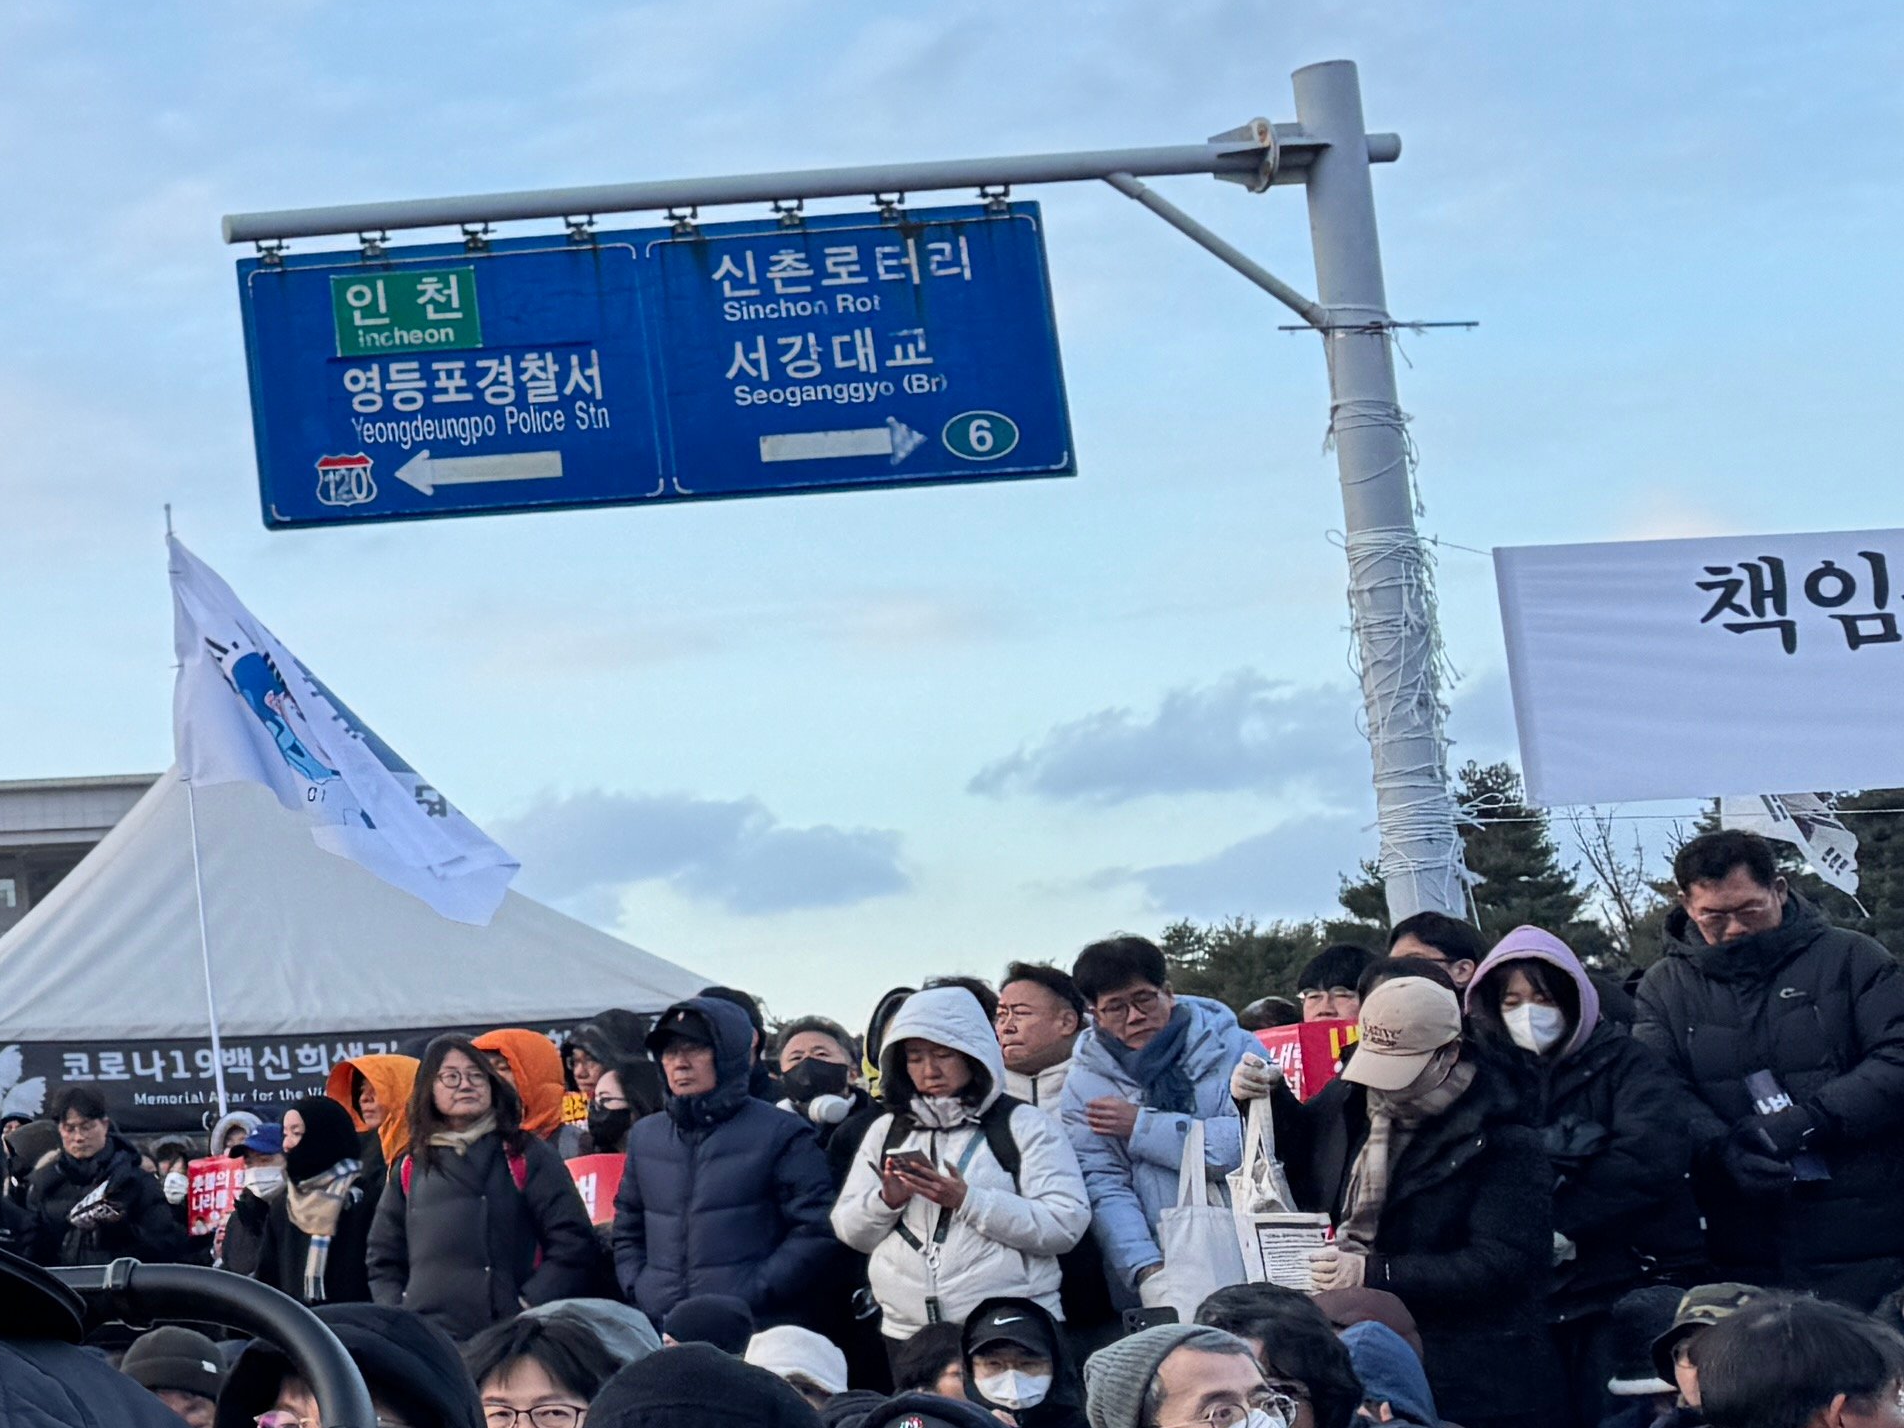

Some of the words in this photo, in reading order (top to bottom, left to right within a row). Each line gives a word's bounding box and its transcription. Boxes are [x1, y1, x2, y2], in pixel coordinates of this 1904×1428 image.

[711, 235, 972, 298] 신촌로터리
[346, 274, 464, 326] 인천
[723, 299, 829, 322] Sinchon
[725, 327, 934, 382] 서강대교
[343, 349, 604, 414] 영등포경찰서
[734, 378, 895, 407] Seoganggyo
[351, 414, 497, 450] Yeongdeungpo
[505, 405, 566, 435] Police
[575, 400, 610, 429] Stn
[968, 419, 994, 452] 6
[324, 468, 368, 502] 120
[1696, 550, 1904, 654] 책임
[134, 1091, 204, 1106] Memorial
[209, 1090, 246, 1104] Atar
[252, 1088, 273, 1102] for
[280, 1087, 306, 1101] the
